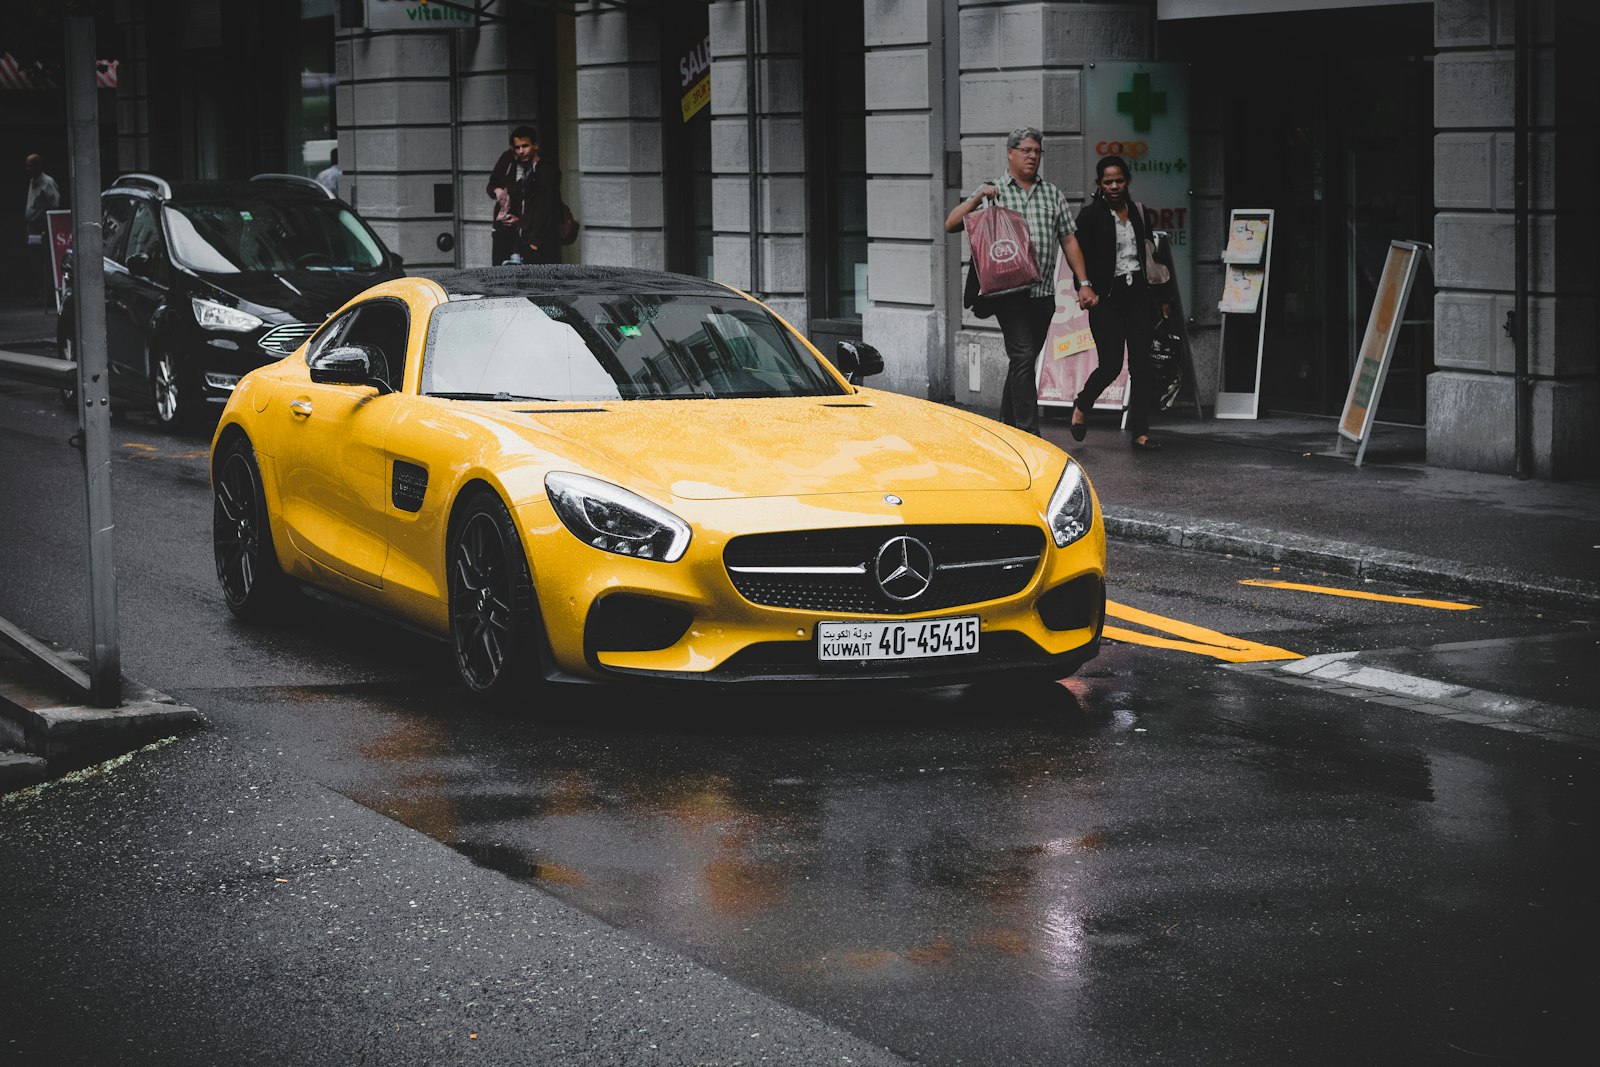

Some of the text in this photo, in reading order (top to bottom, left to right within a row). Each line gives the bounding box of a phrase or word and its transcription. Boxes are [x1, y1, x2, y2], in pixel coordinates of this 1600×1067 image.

[406, 6, 471, 22] vitality
[1095, 141, 1148, 159] coop
[1128, 160, 1172, 173] itality
[1149, 208, 1187, 229] ORT
[1167, 230, 1187, 246] RIE
[823, 627, 873, 641] دولة الكويت
[879, 621, 975, 655] 40-45415
[823, 642, 873, 657] KUWAIT
